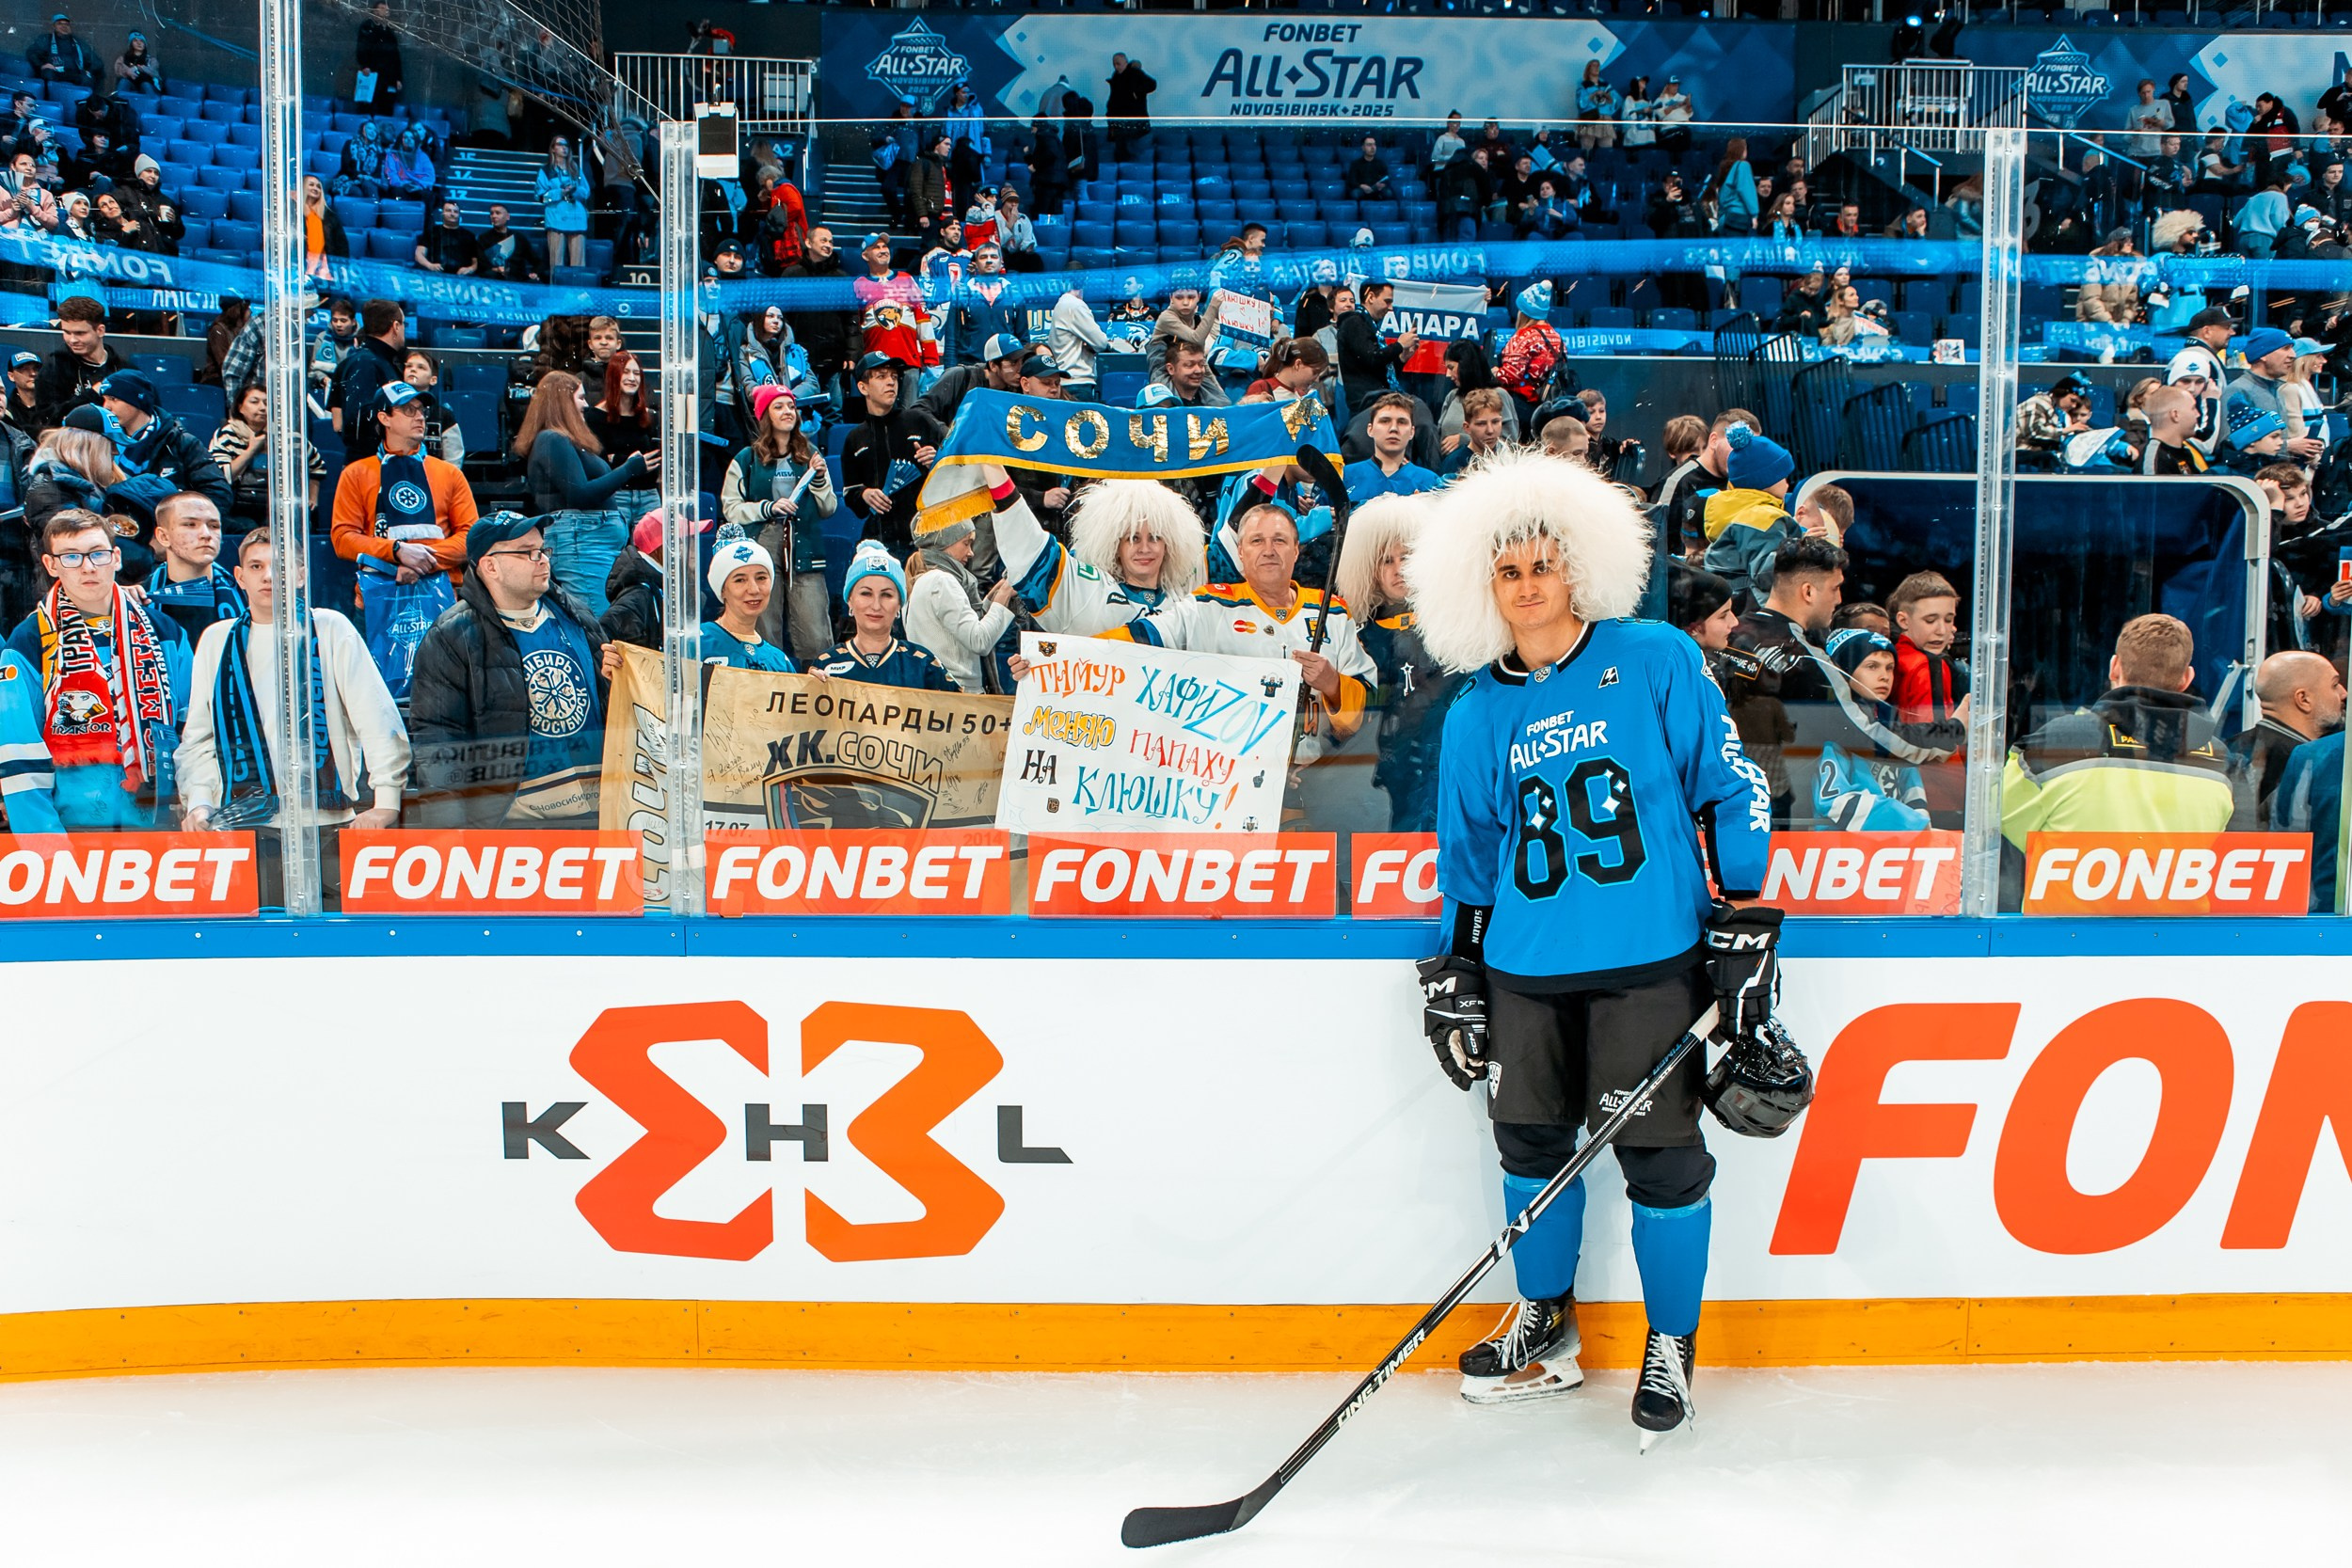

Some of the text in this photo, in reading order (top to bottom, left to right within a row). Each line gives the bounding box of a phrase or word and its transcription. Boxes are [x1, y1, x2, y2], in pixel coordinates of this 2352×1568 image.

[1263, 23, 1362, 42] FONBET
[1230, 103, 1394, 117] NOVOSIBIRSK 2025
[629, 272, 650, 285] 10
[1380, 310, 1480, 340] АМАРА
[1006, 404, 1230, 463] СОЧИ
[1029, 657, 1126, 698] ТИМУР
[51, 722, 112, 736] TRAKTOR
[766, 691, 954, 735] ЛЕОПАРДЫ
[961, 713, 1012, 736] 50+
[1526, 710, 1575, 736] FONBET
[1019, 749, 1057, 785] НА
[1129, 728, 1236, 787] ПАПАХУ
[1820, 759, 1840, 799] 2
[1514, 755, 1649, 903] 89
[347, 846, 637, 900] FONBET
[712, 846, 1004, 900] FONBET
[1034, 848, 1328, 903] FONBET
[2029, 847, 2305, 901] FONBET
[1706, 930, 1772, 950] CM
